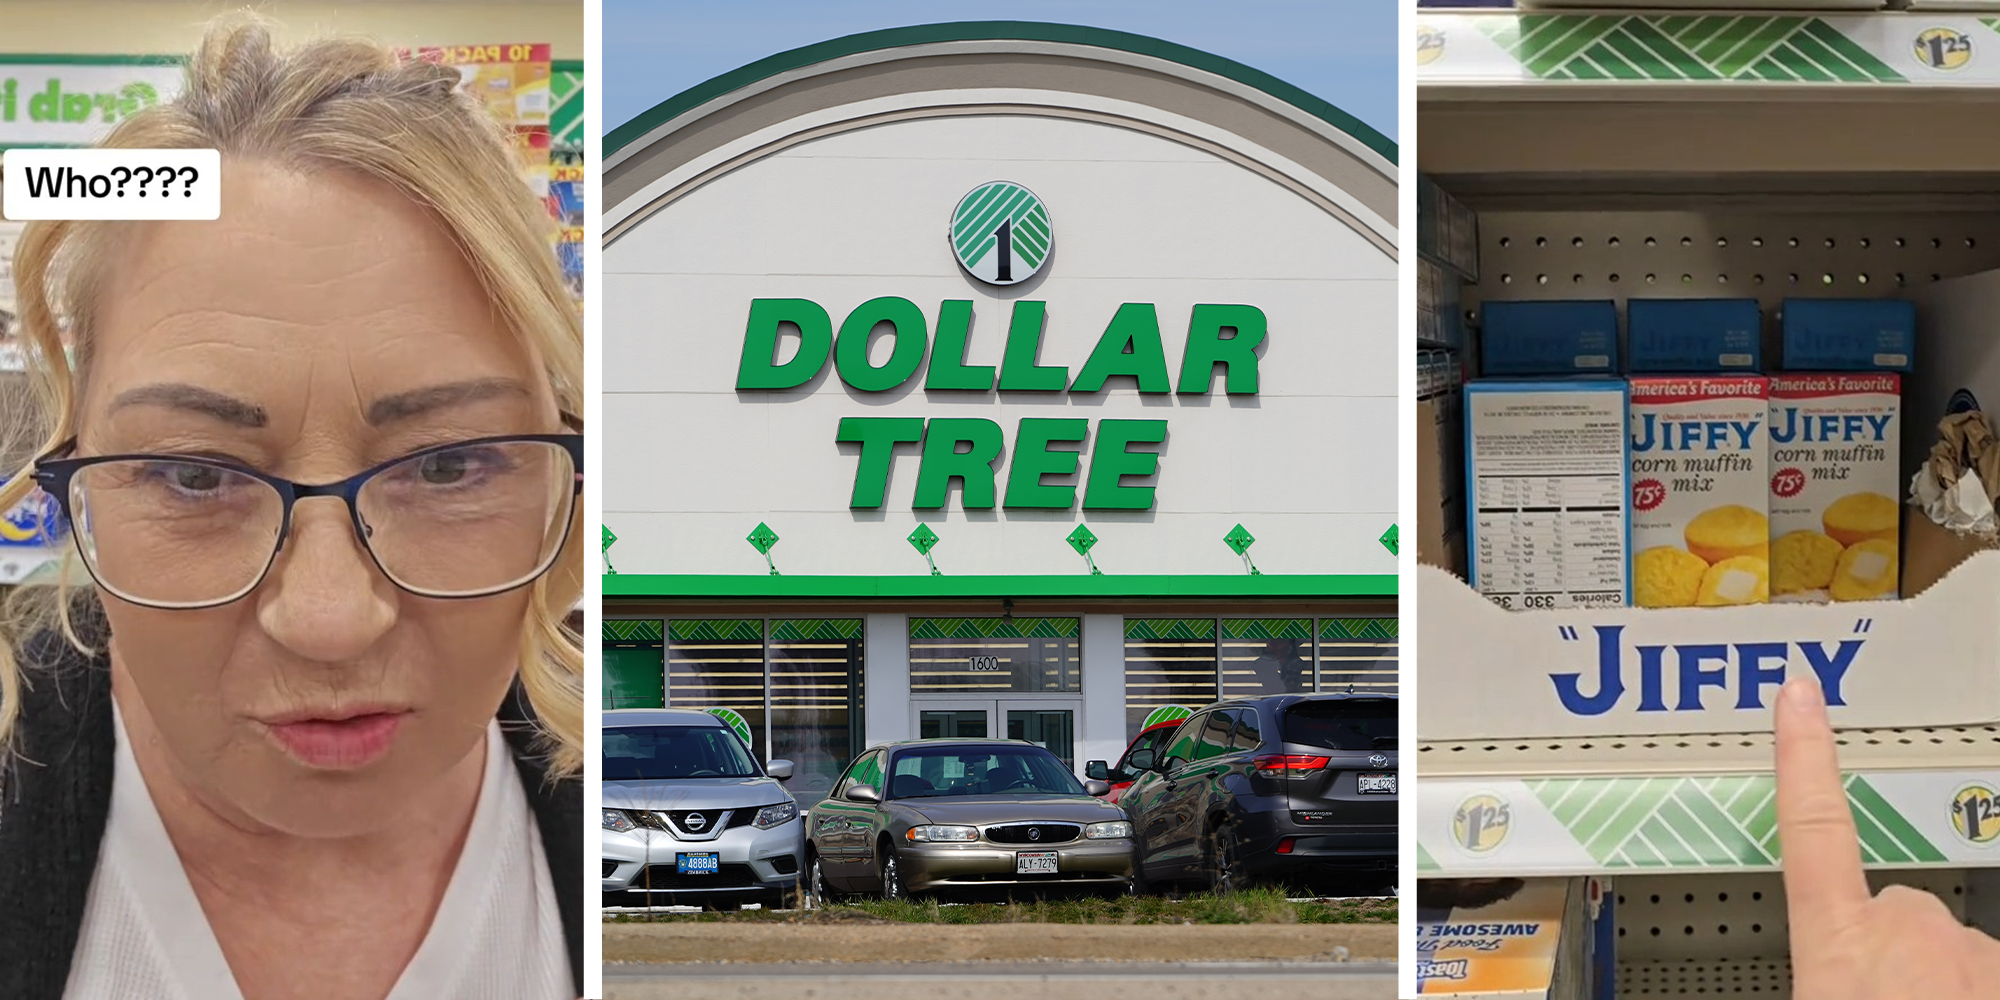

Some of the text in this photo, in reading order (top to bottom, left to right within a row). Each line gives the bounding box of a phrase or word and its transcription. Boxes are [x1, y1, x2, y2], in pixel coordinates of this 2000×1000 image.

[735, 296, 1268, 394] DOLLAR
[1700, 380, 1762, 396] Favorite
[1768, 376, 1894, 391] America's Favorite
[1774, 444, 1885, 462] corn muffin
[835, 416, 1169, 509] TREE
[1632, 459, 1678, 472] corn
[1684, 453, 1753, 472] muffin
[1812, 463, 1850, 480] mix
[1672, 473, 1714, 492] mix
[1524, 596, 1555, 608] 330
[1572, 593, 1622, 604] Calories
[971, 656, 999, 670] 1600
[688, 857, 718, 869] 4888AB
[1019, 858, 1057, 869] ALY-7279
[1430, 924, 1540, 936] AWESOME
[1440, 939, 1503, 951] Food
[1417, 960, 1466, 979] Toast
